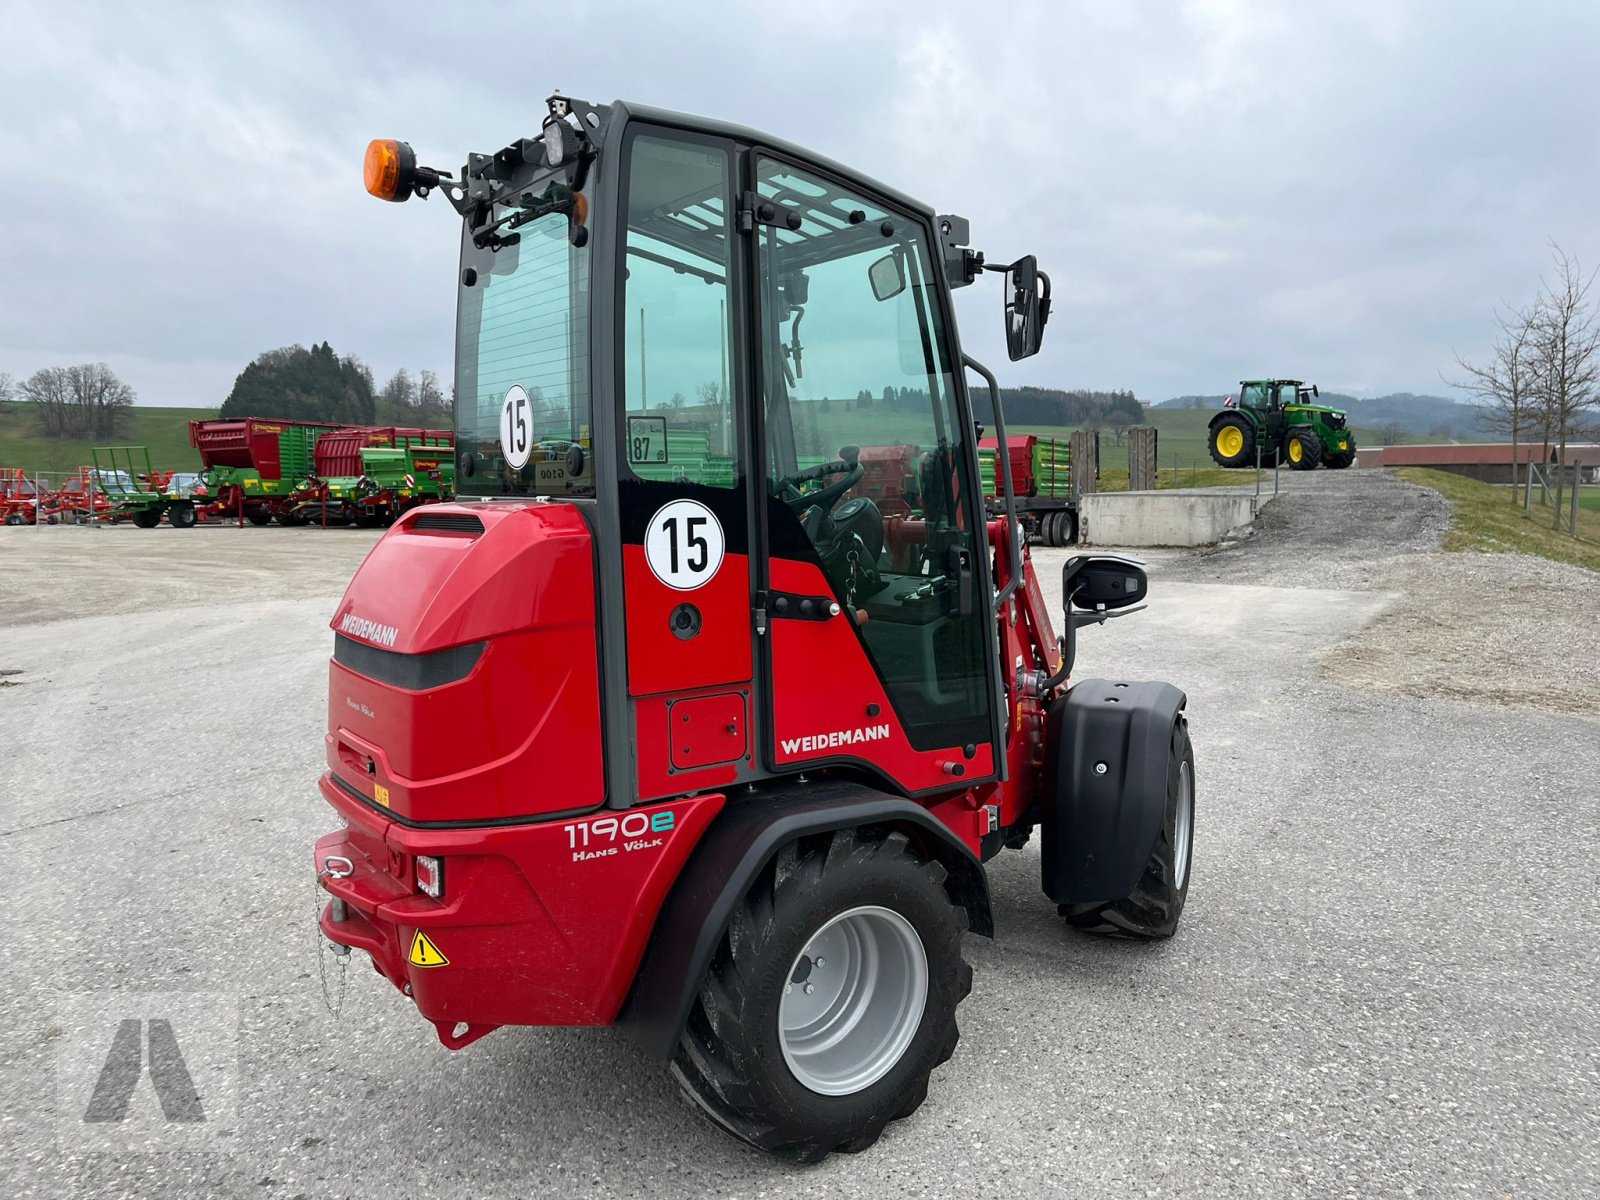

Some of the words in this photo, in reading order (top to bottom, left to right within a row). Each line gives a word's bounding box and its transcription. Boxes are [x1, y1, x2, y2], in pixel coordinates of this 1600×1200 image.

[506, 399, 526, 454] 15
[634, 437, 650, 461] 87
[662, 516, 708, 574] 15
[341, 613, 399, 647] WEIDEMANN
[780, 724, 890, 755] WEIDEMANN
[564, 810, 675, 849] 1190e
